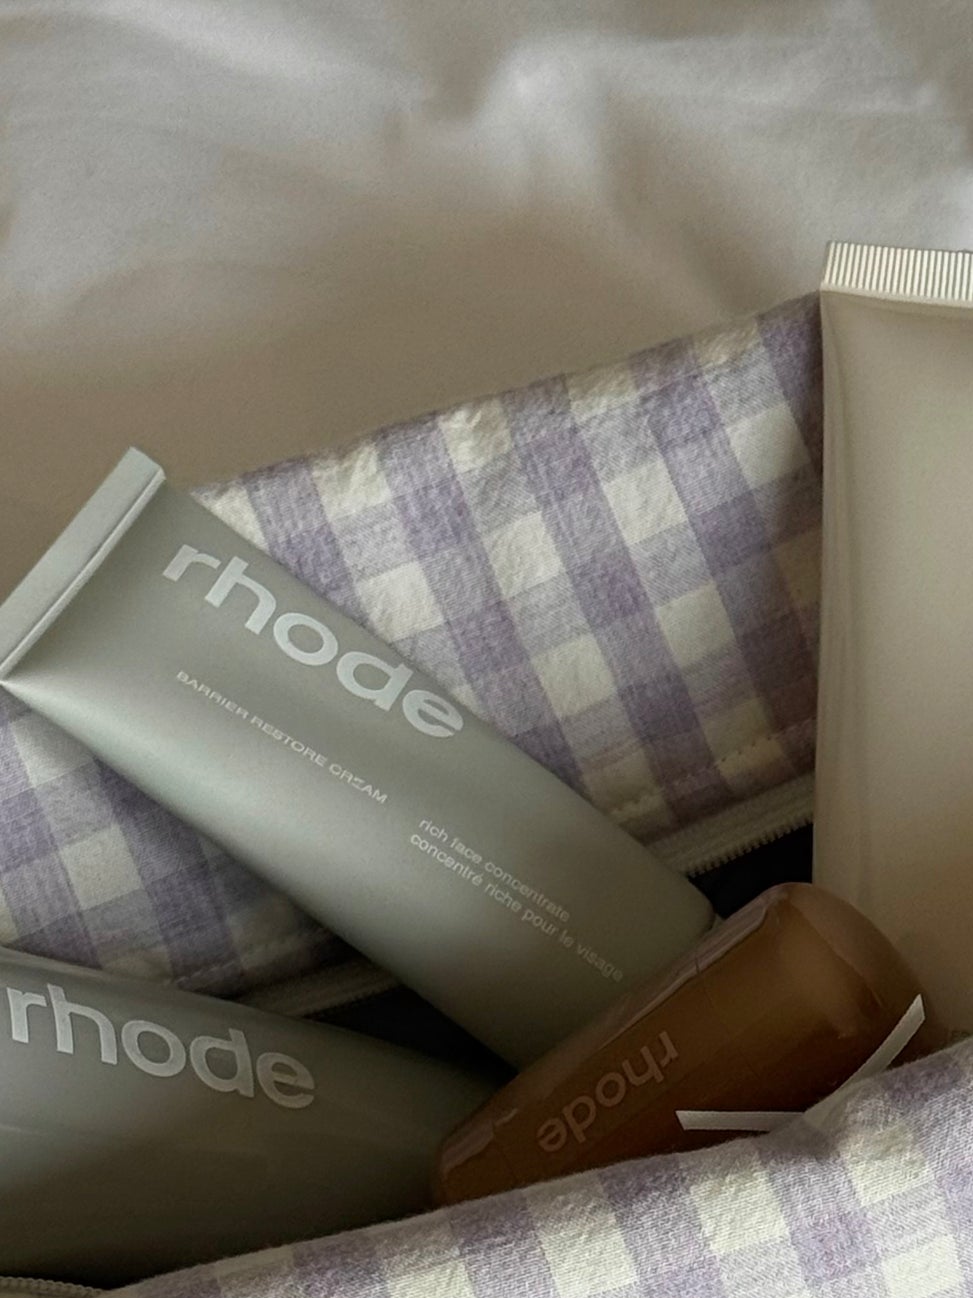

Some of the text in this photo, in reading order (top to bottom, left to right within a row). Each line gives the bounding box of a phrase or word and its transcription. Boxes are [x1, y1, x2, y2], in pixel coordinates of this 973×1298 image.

[162, 544, 464, 738] rhode
[176, 670, 388, 804] BARRIER RESTORE CREAM
[410, 834, 623, 982] concentré riche pour le visage
[419, 819, 570, 922] rich face concentrate
[6, 983, 315, 1109] rhode
[536, 1031, 679, 1154] rhode
